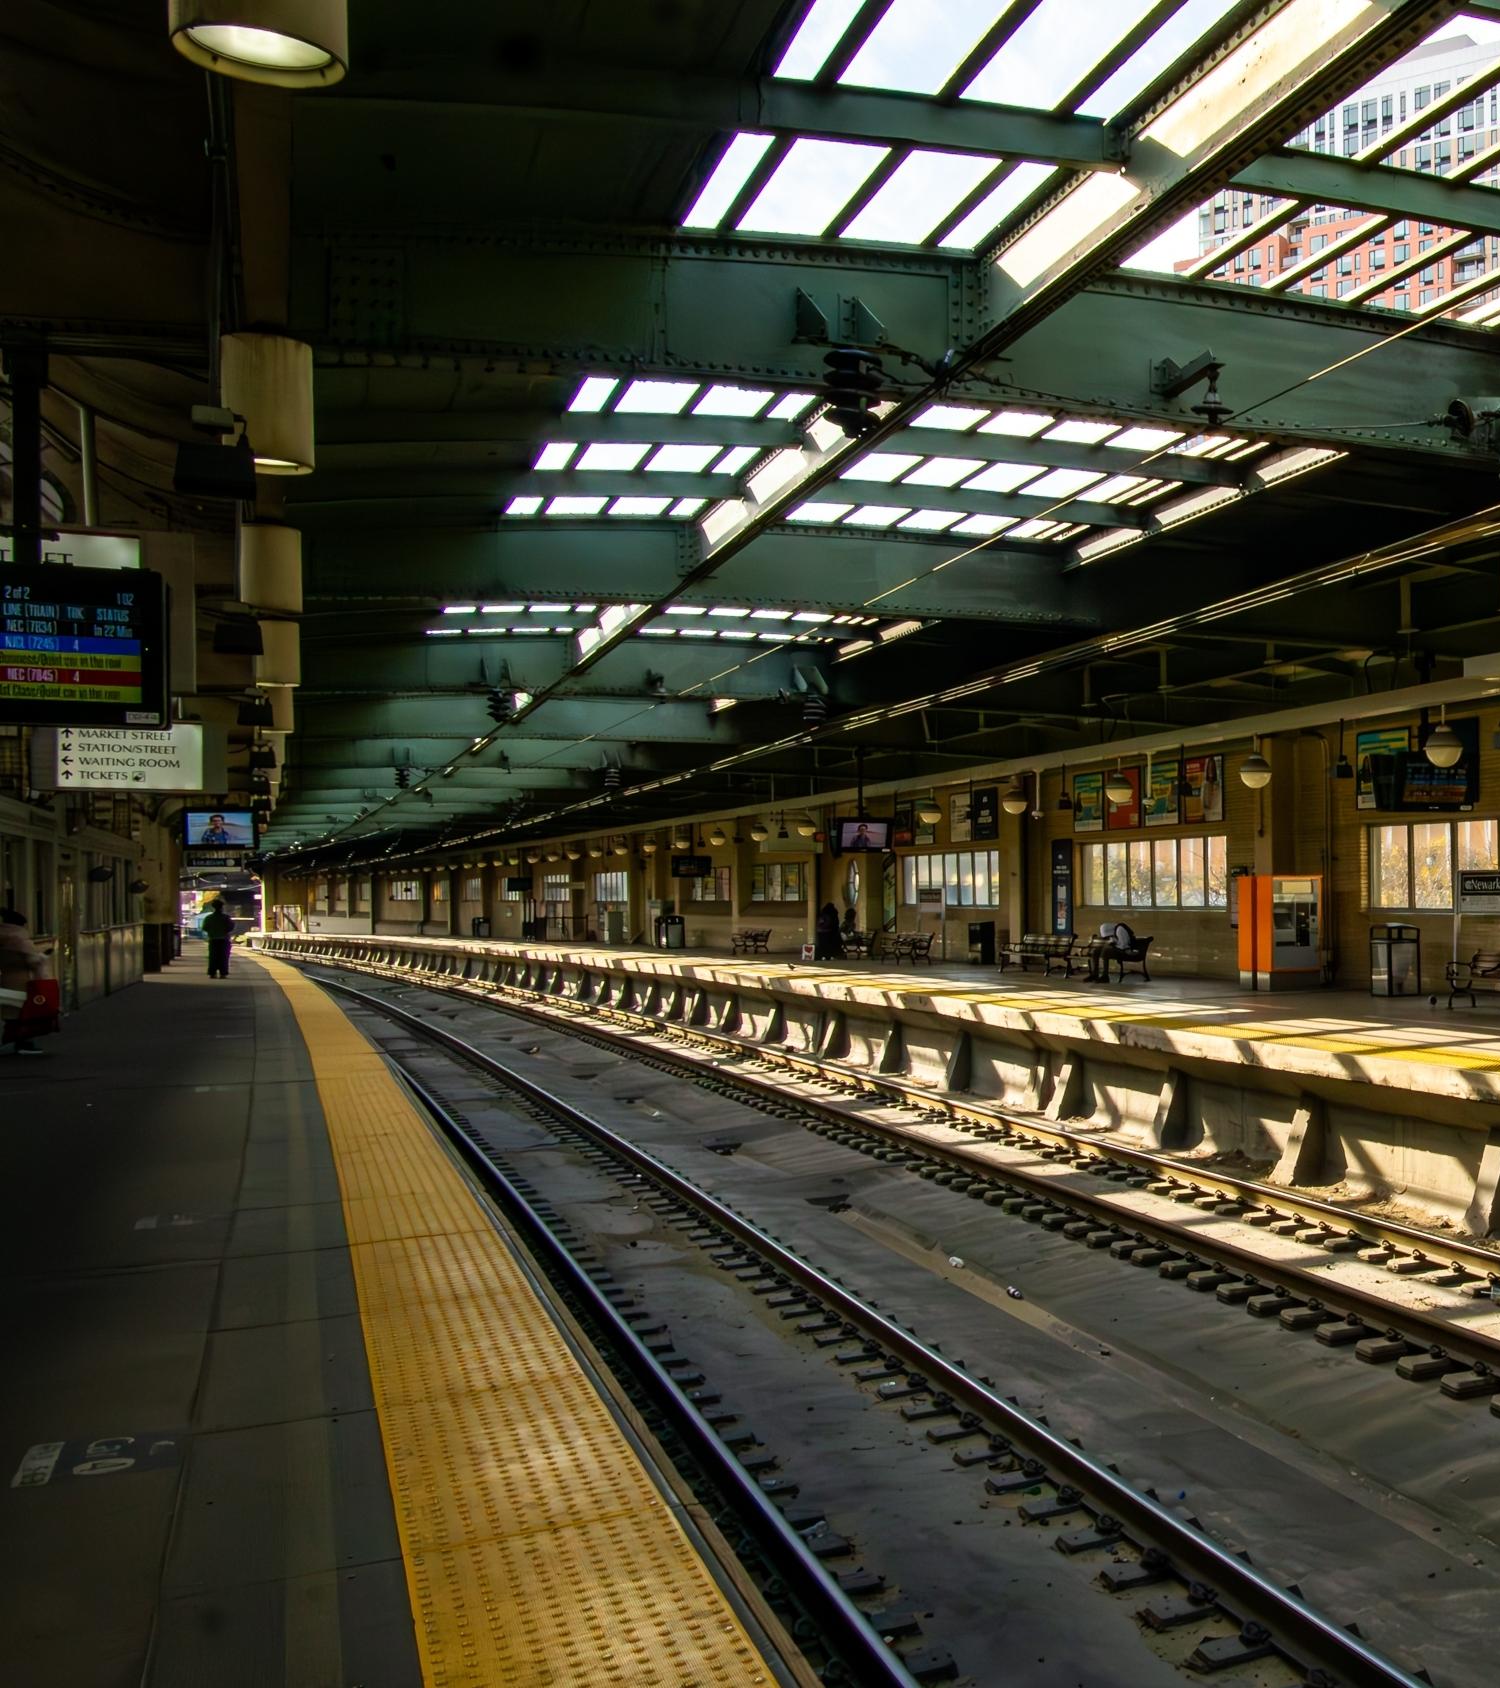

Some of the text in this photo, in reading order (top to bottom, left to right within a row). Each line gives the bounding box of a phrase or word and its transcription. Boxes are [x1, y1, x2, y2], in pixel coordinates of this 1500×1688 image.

[4, 585, 12, 598] 2
[23, 586, 30, 600] 2
[96, 608, 130, 623] STATUS
[73, 640, 79, 651] 4
[7, 668, 25, 681] NEC
[73, 671, 80, 682] 4
[79, 729, 172, 741] MARKET STREET
[78, 743, 176, 754] STATION/STREET
[79, 757, 180, 768] WAITING ROOM
[79, 769, 128, 780] TICKETS
[1471, 877, 1500, 890] Newark
